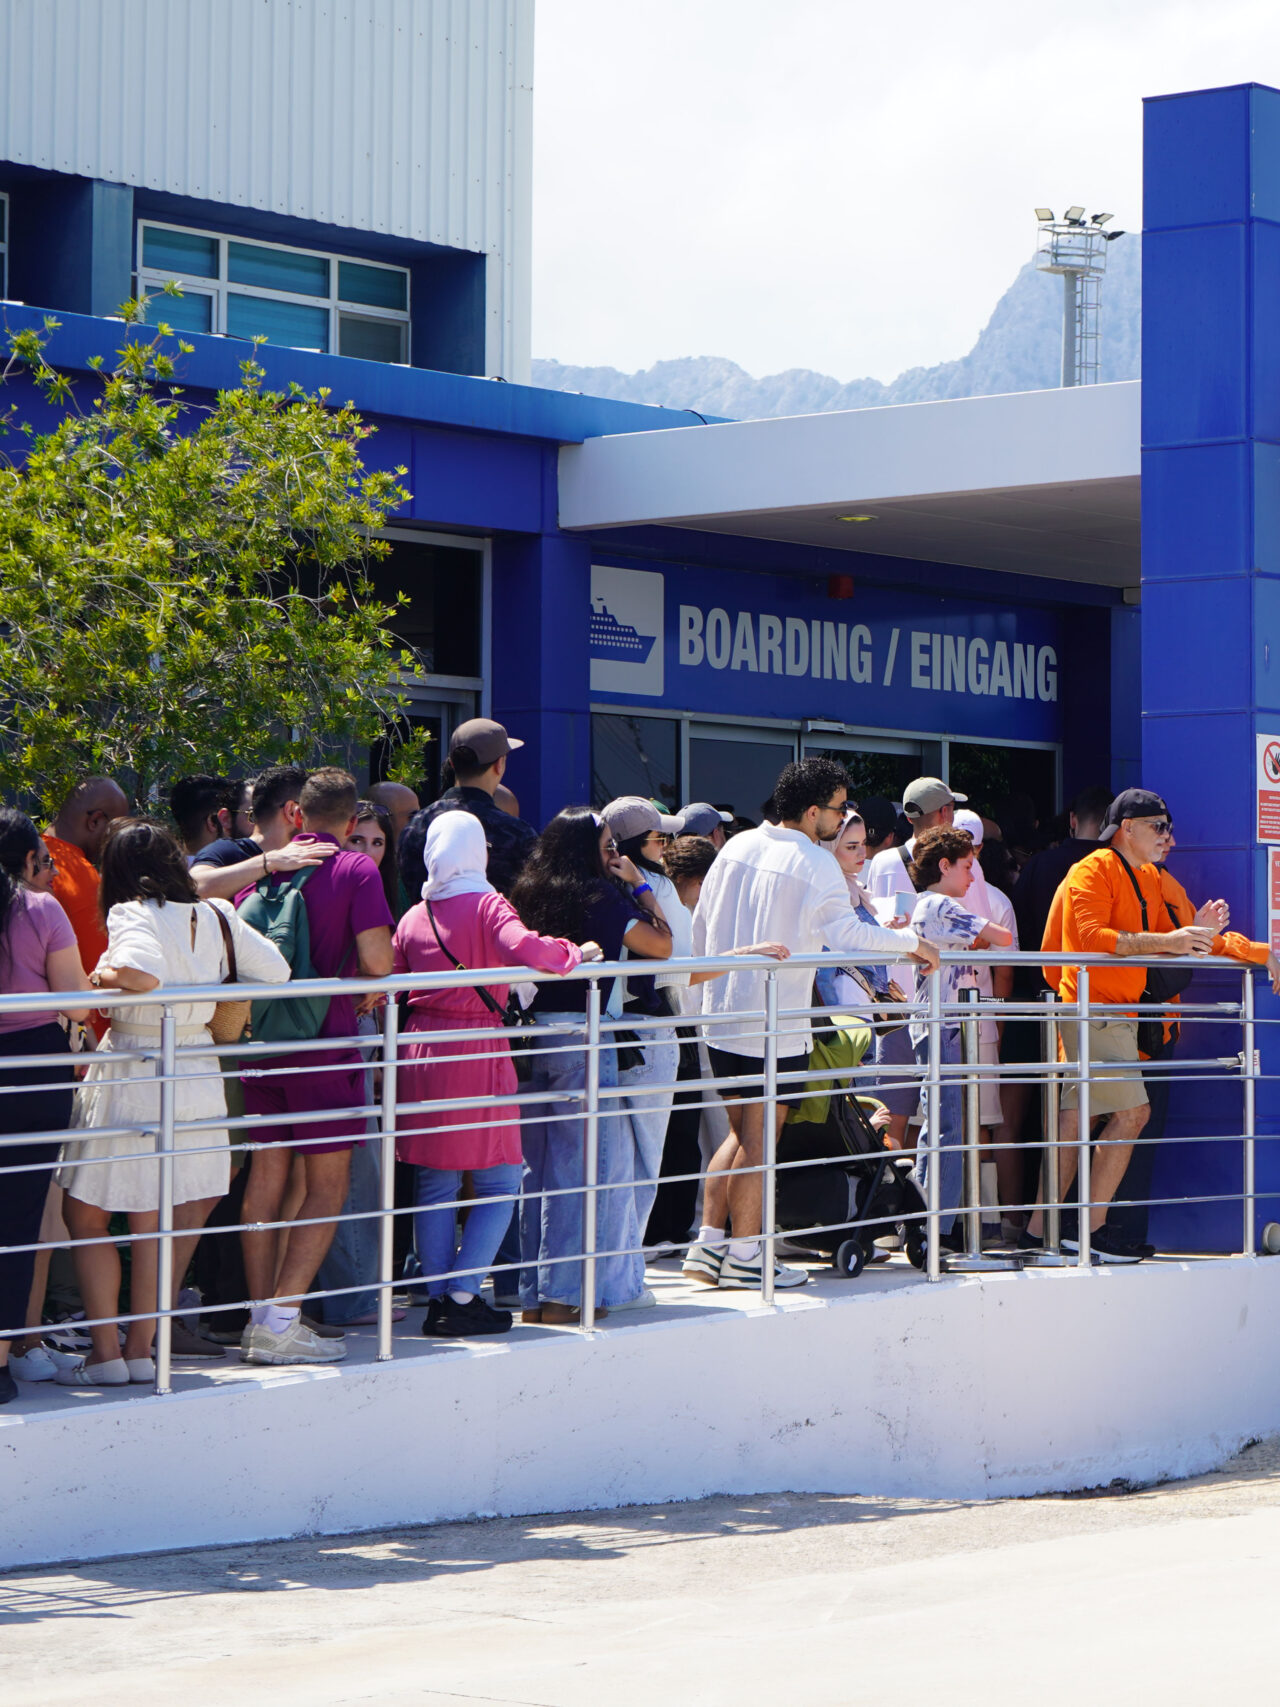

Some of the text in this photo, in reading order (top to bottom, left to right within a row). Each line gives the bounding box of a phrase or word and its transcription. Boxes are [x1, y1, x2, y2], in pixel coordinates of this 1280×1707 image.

[679, 604, 1058, 702] BOARDING / EINGANG
